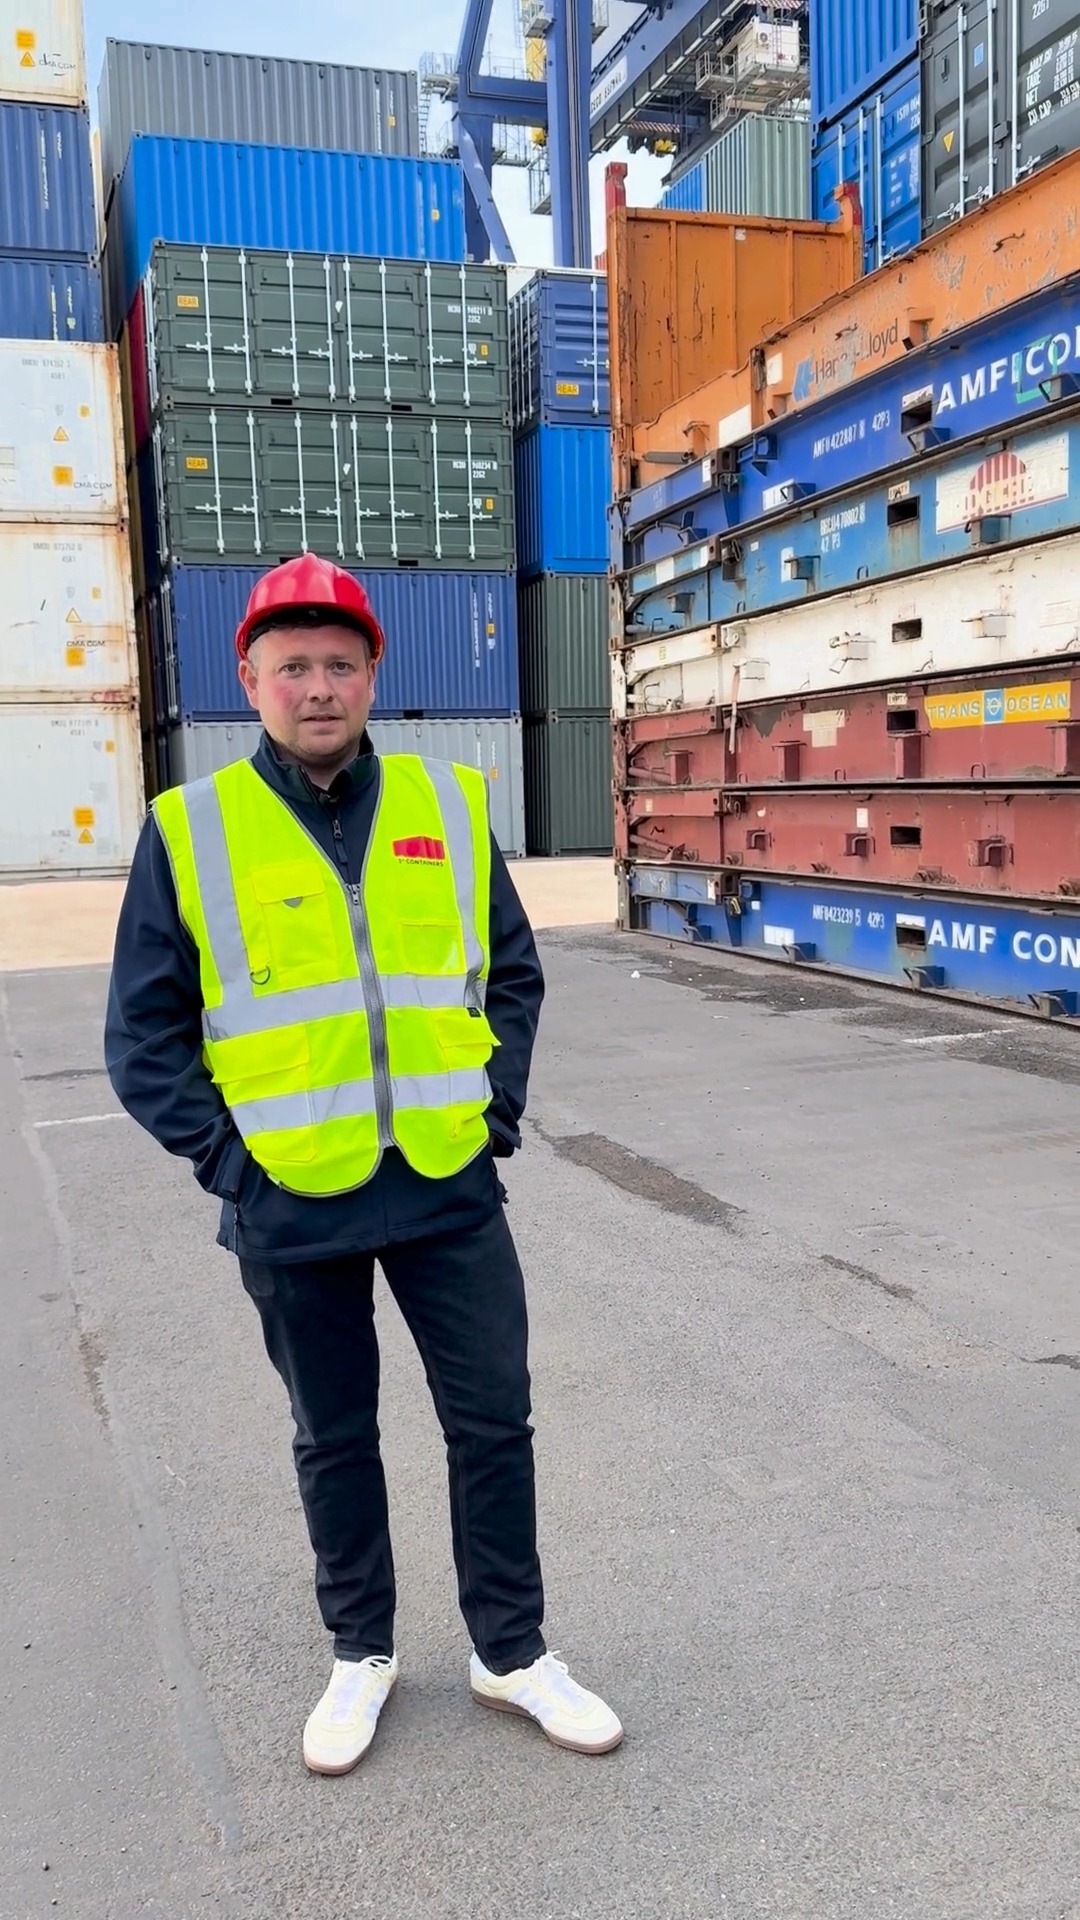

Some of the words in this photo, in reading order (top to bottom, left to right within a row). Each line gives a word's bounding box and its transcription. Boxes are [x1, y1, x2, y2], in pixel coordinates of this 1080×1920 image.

[1025, 86, 1039, 108] NET
[927, 700, 981, 719] TRANS
[1006, 692, 1069, 713] OCEAN
[406, 858, 444, 867] CONTAINERS
[927, 919, 997, 954] AMF
